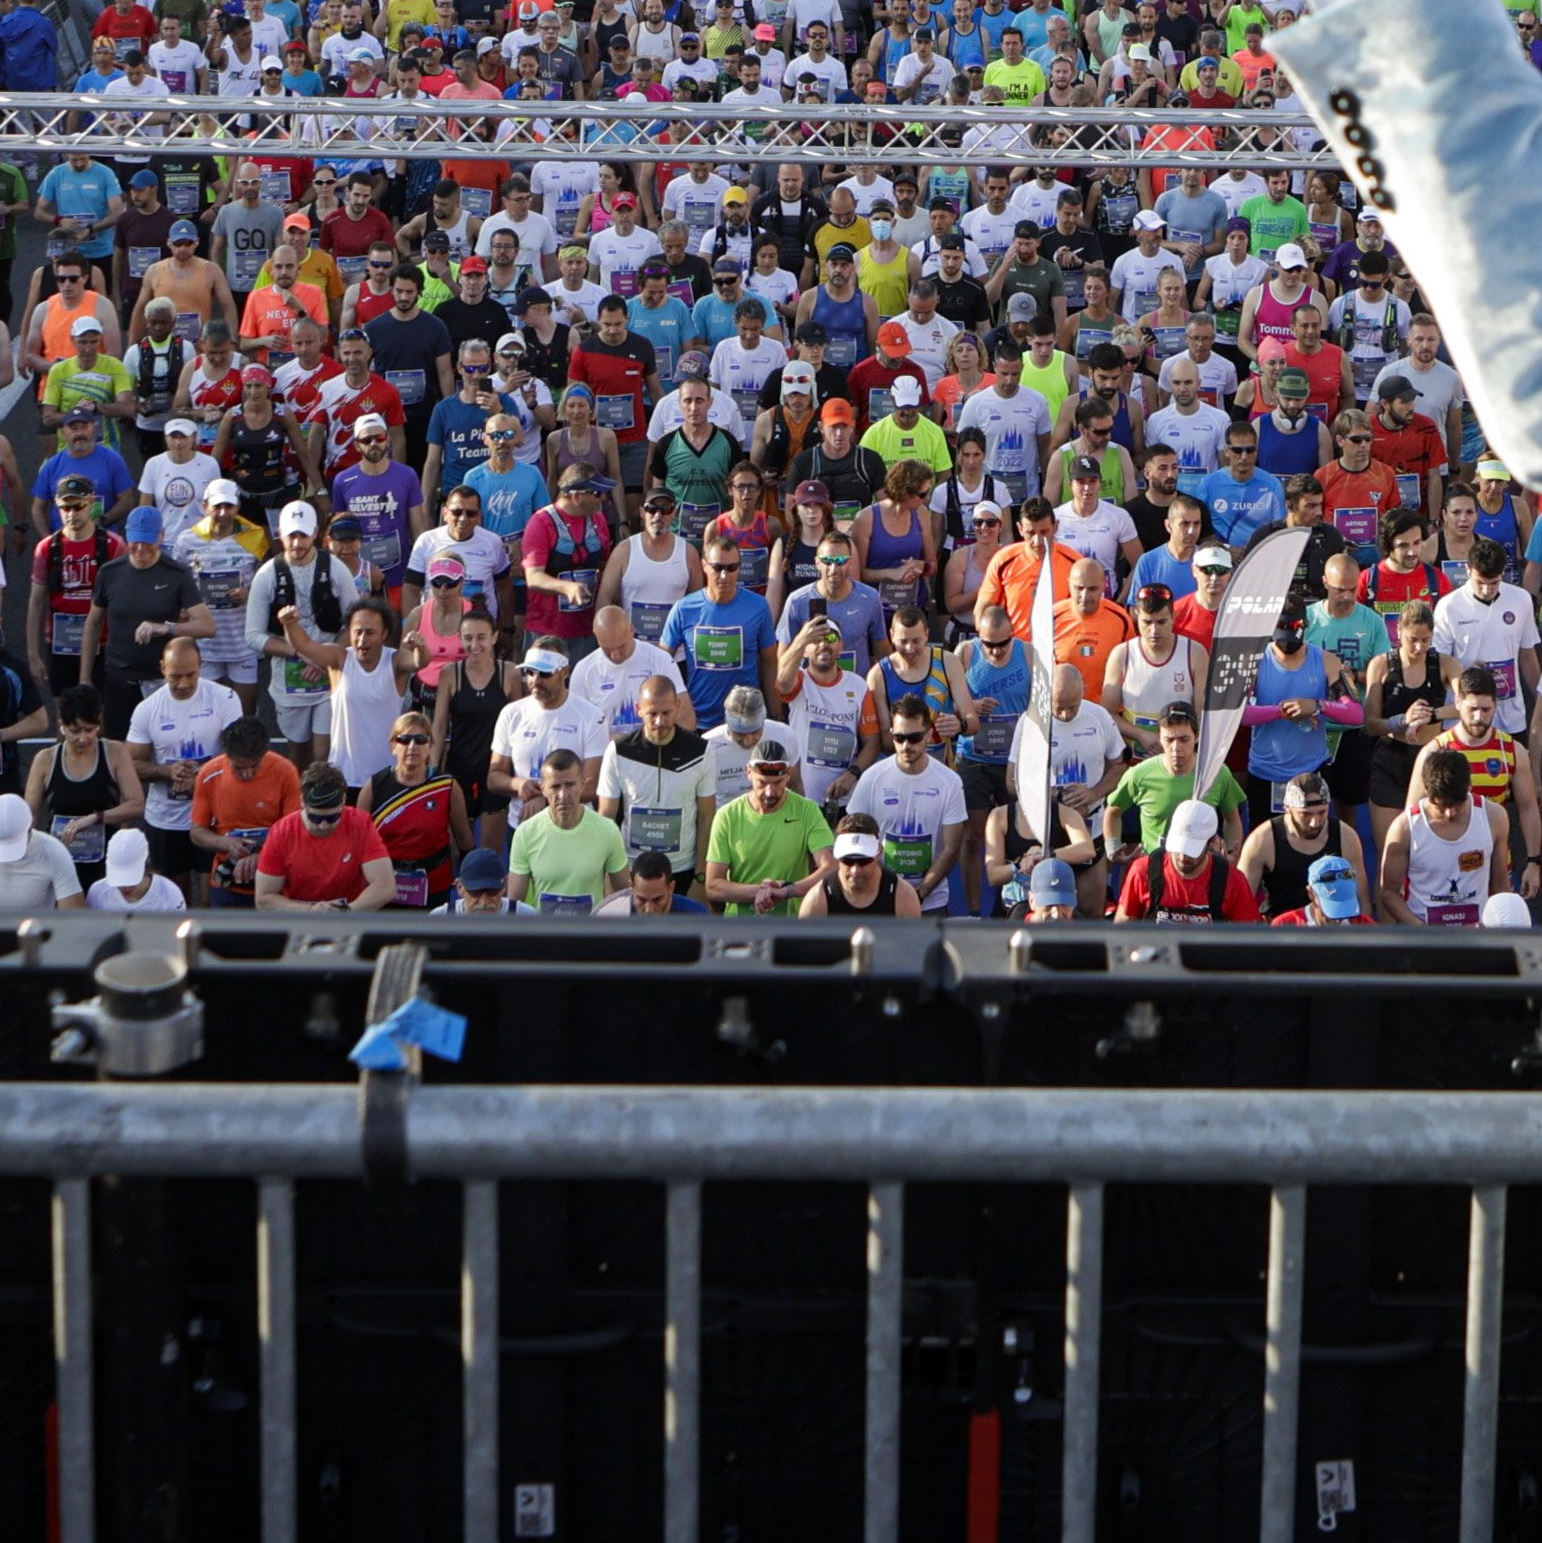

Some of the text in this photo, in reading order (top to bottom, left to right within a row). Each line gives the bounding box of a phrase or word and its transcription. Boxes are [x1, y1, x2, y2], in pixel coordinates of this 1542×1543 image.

[234, 228, 266, 251] GO
[266, 309, 289, 320] NEV
[1259, 323, 1298, 339] Tomm
[451, 428, 487, 443] La Pi
[457, 447, 491, 460] Team
[997, 456, 1023, 468] 2022
[1232, 503, 1269, 511] ZURICH
[1345, 520, 1368, 528] ARTHUR
[795, 562, 816, 570] MIDN
[1226, 596, 1286, 615] POLAR
[824, 737, 839, 745] TITU
[719, 767, 744, 776] MITJA
[892, 849, 923, 857] ANTONIO
[1441, 912, 1465, 921] IGNASI
